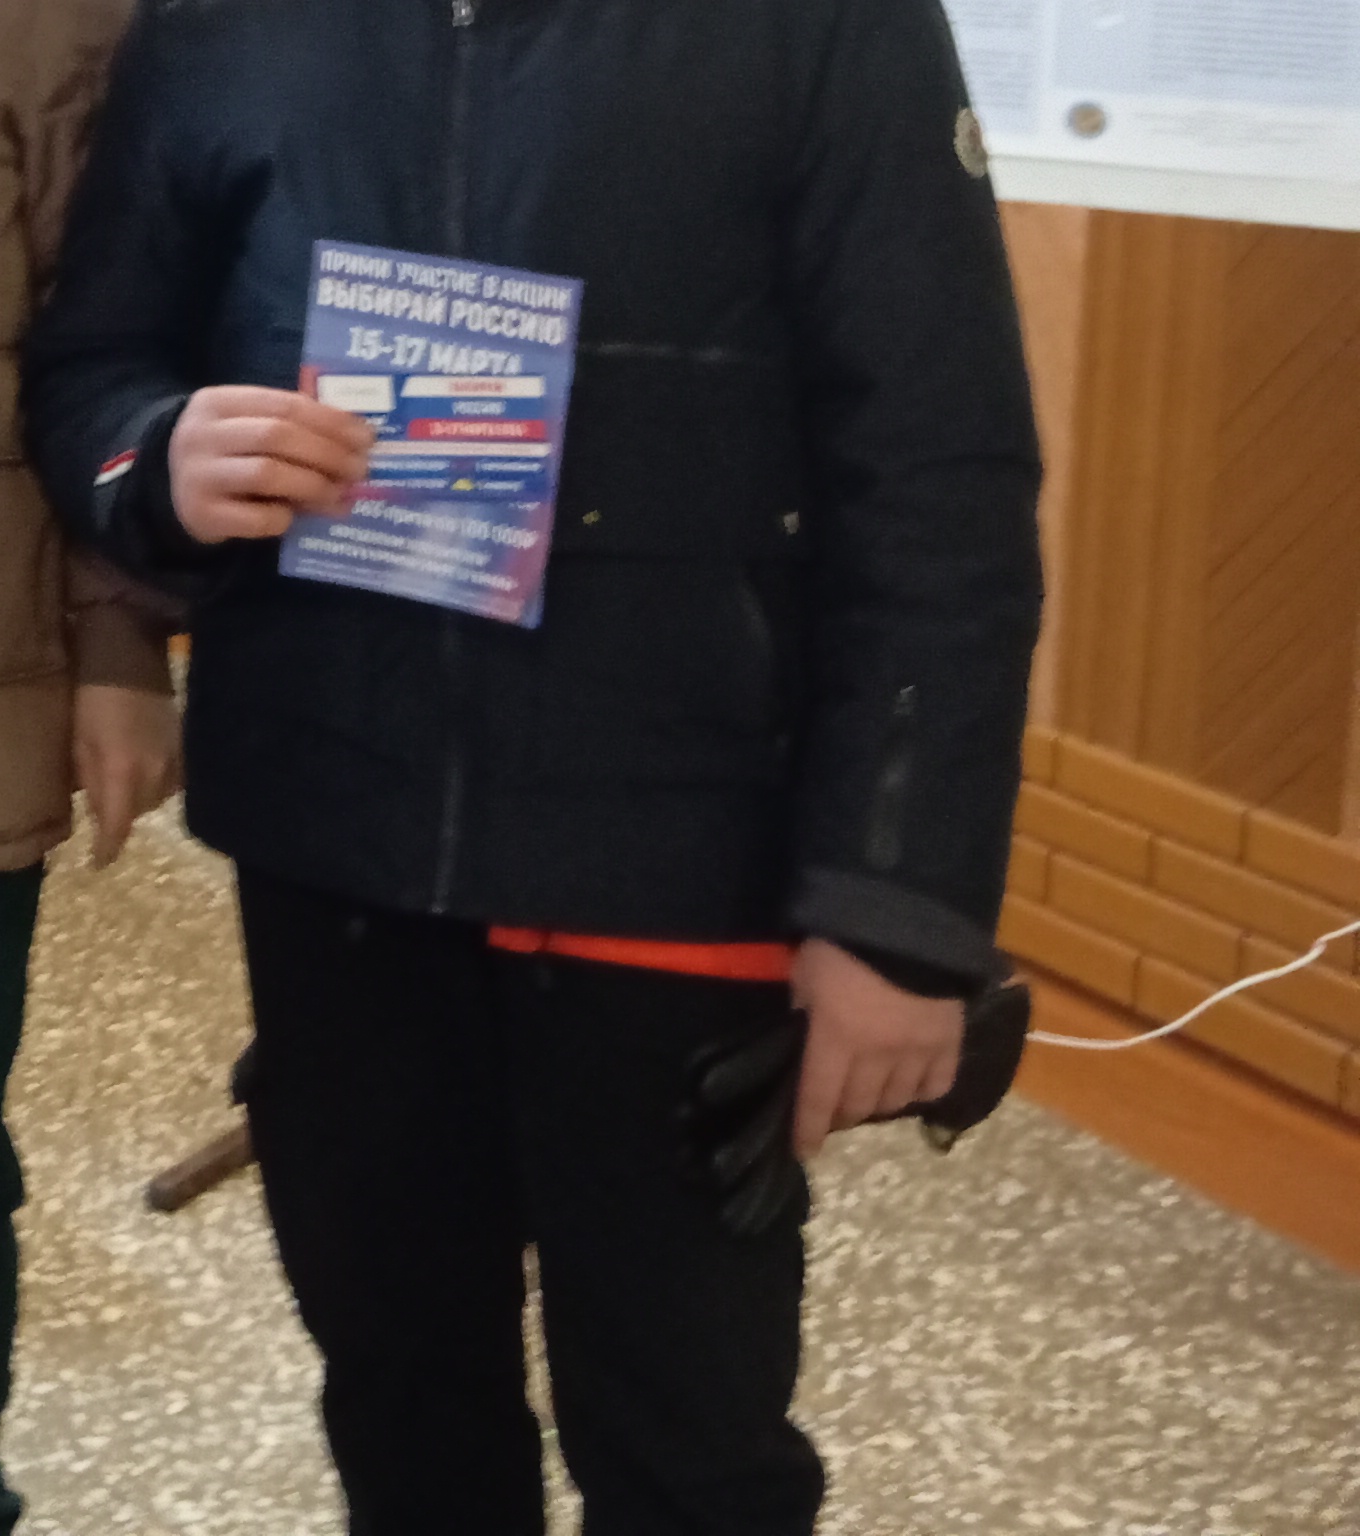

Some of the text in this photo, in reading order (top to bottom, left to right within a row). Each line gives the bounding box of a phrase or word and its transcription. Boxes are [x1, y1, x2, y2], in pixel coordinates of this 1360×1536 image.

[316, 276, 568, 346] ВЫБИРАЙ РОССИЮ
[428, 341, 523, 375] МАРТА
